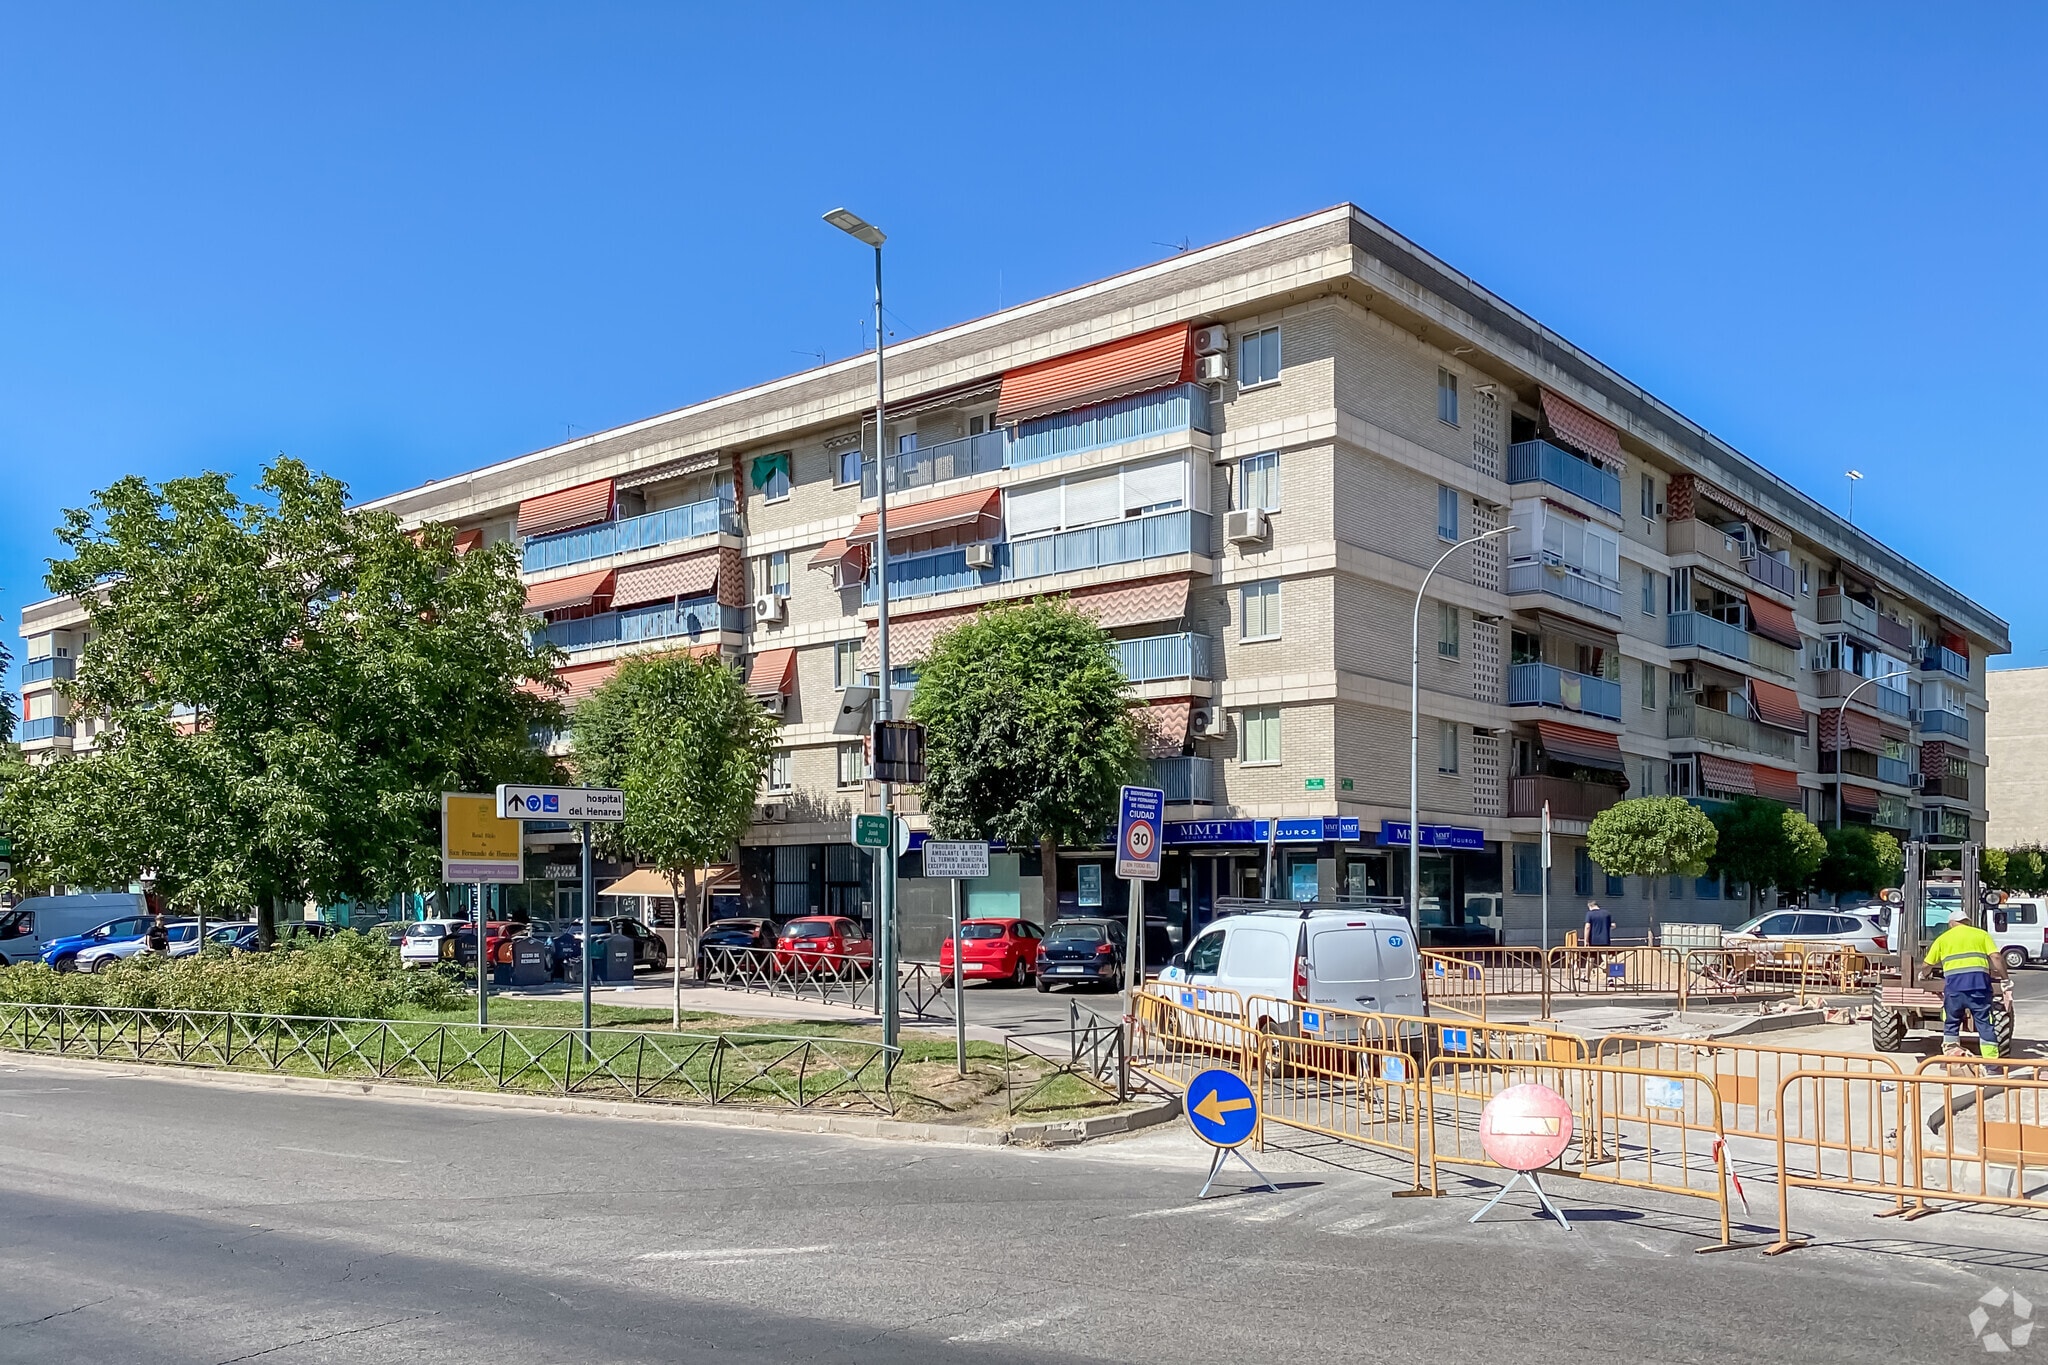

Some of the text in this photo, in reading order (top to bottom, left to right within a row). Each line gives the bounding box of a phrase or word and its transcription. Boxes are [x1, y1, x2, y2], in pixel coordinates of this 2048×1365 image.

[586, 794, 621, 804] hospital
[1137, 797, 1158, 805] FERNANDO
[568, 807, 583, 816] del
[586, 807, 622, 817] Henares
[1129, 810, 1155, 820] CIUDAD
[1181, 824, 1227, 835] MMT
[1324, 823, 1339, 831] MMT
[1341, 823, 1358, 831] MMT
[1262, 829, 1317, 837] SGUROS
[1396, 828, 1426, 841] MT
[1133, 833, 1149, 846] 30
[461, 849, 487, 857] Fernando
[496, 850, 518, 858] Henares
[1390, 937, 1401, 946] 37
